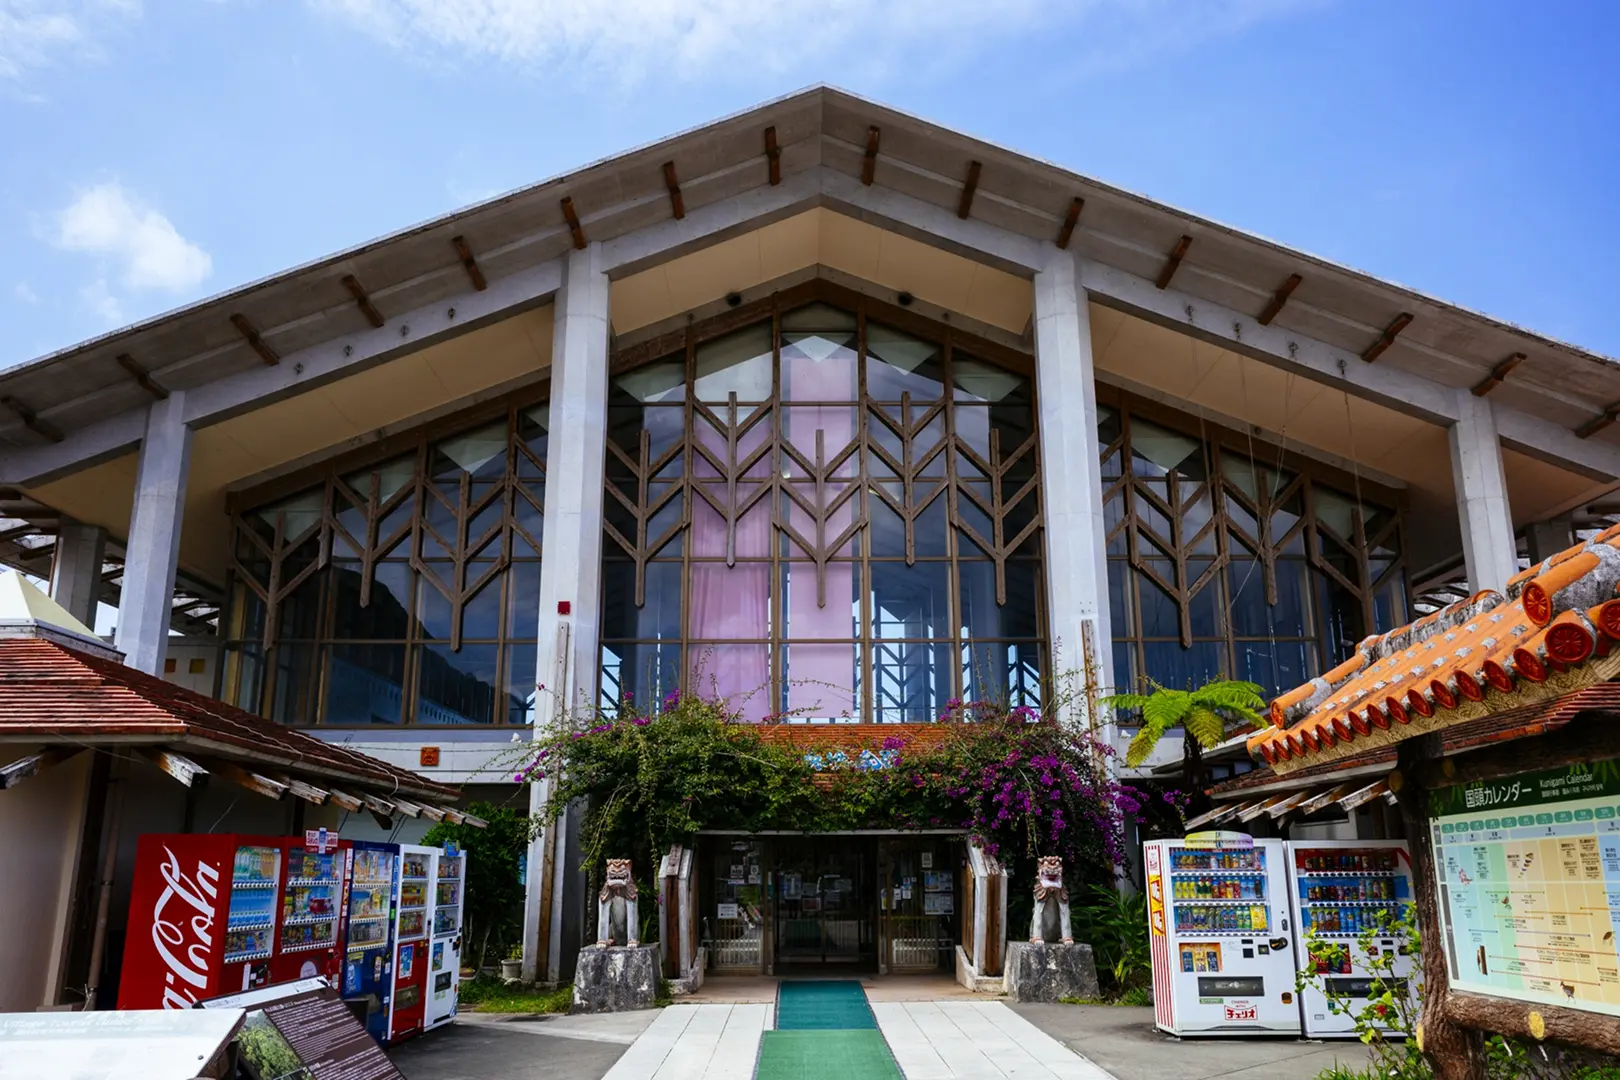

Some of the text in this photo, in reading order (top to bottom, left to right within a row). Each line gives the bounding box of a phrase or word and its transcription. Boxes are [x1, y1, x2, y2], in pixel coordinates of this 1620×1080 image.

[1539, 772, 1593, 788] Kunigami Calendar
[1465, 782, 1532, 808] 国頭カレンダー
[1227, 1008, 1255, 1019] チェリオ
